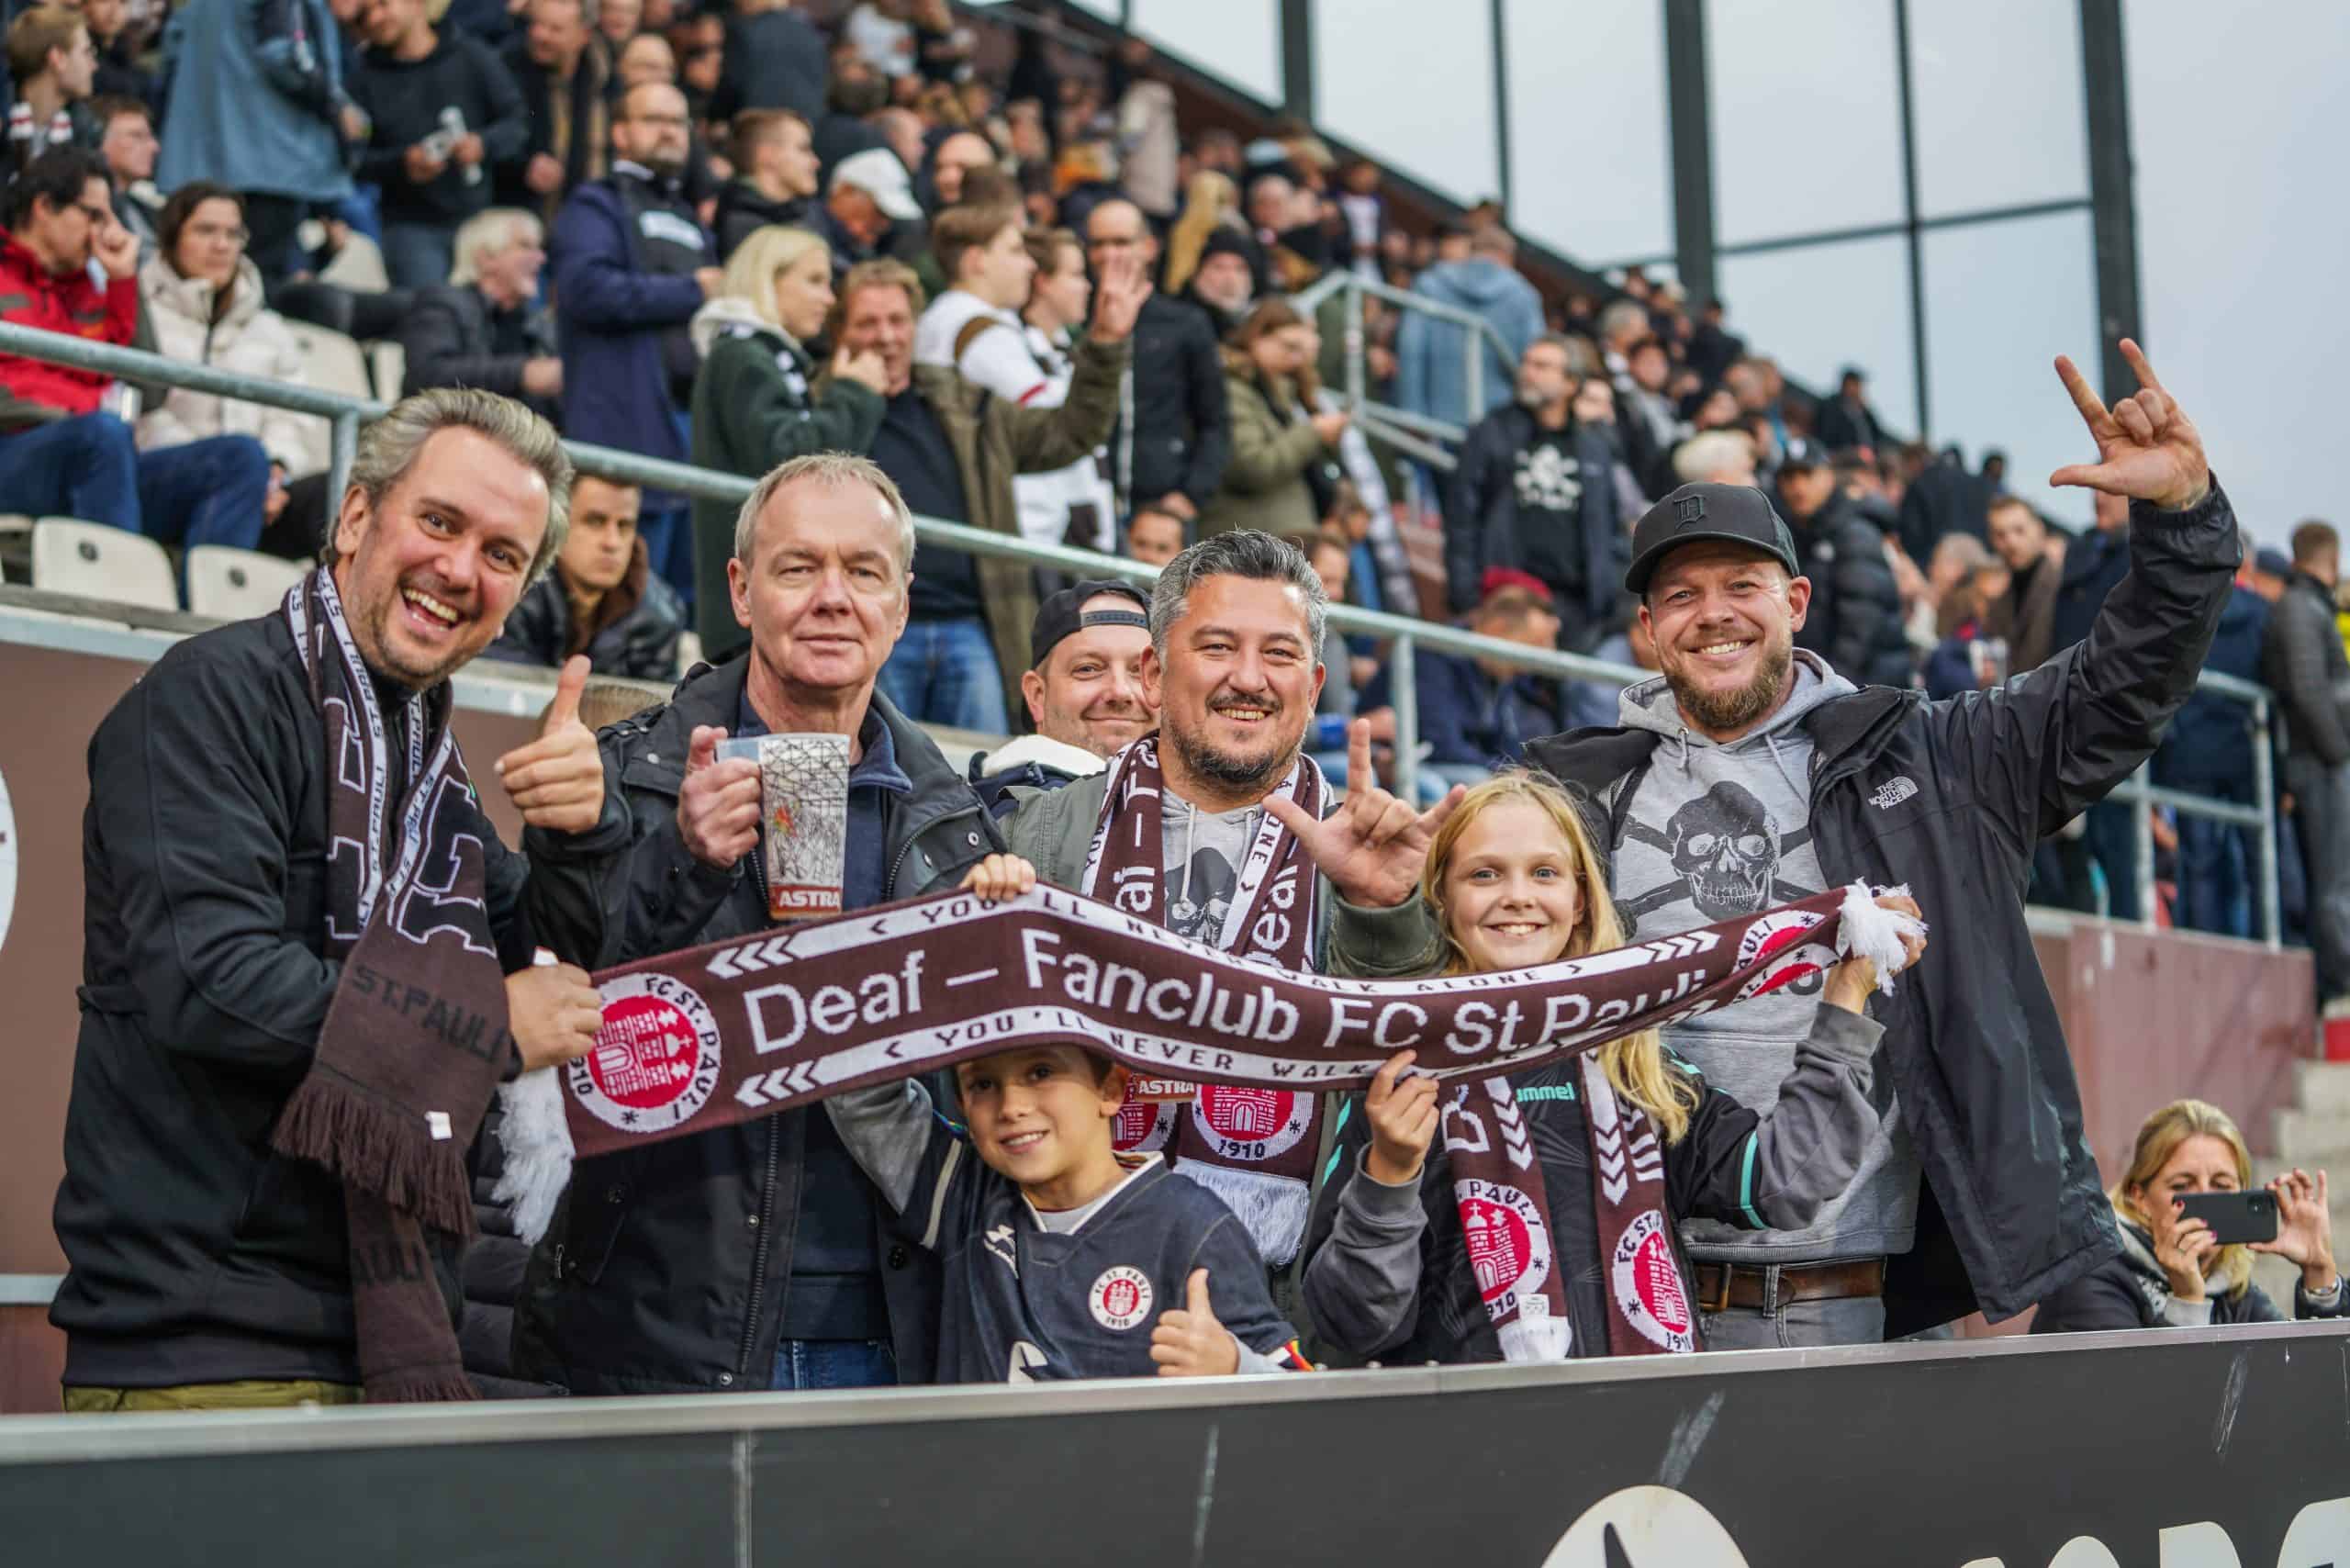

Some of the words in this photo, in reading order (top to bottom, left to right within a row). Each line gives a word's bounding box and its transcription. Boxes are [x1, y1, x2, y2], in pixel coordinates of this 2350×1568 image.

[1868, 790, 1898, 806] NORTH
[1874, 780, 1896, 794] THE
[1879, 793, 1903, 810] FACE
[779, 890, 841, 908] ASTRA
[743, 949, 925, 1055] Deaf
[1021, 927, 1301, 1042] Fanclub
[1322, 996, 1428, 1048] FC
[645, 977, 675, 996] FC
[674, 1031, 719, 1120] PAULI
[1109, 1029, 1234, 1070] NEVER
[1271, 1061, 1372, 1079] WALK
[570, 1056, 594, 1095] 910
[1138, 1080, 1195, 1095] ASTRA
[1218, 1139, 1266, 1159] 1910
[1469, 1181, 1540, 1226] PAULI
[1617, 1236, 1637, 1263] FC
